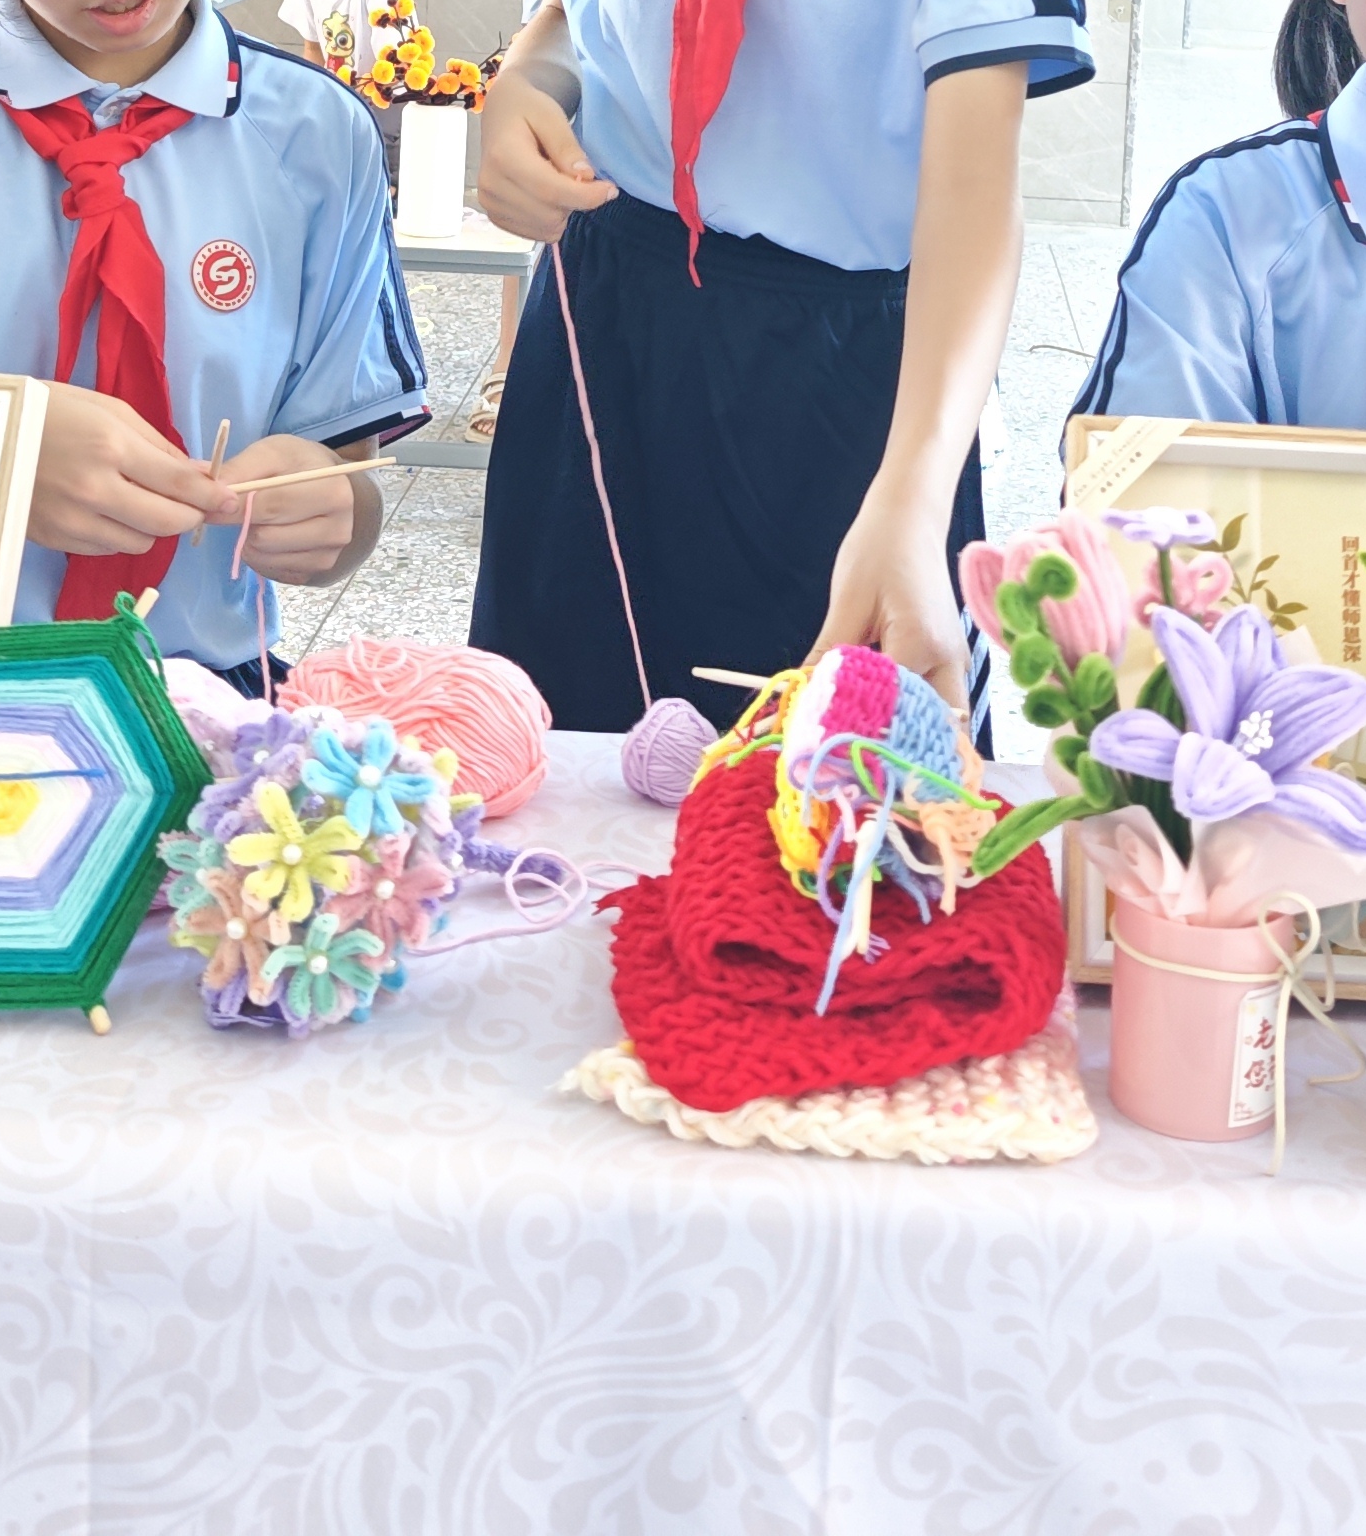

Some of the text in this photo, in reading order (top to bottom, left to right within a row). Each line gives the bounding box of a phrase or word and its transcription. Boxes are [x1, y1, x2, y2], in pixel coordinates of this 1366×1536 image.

[1341, 536, 1361, 663] 回首才懂师恩深
